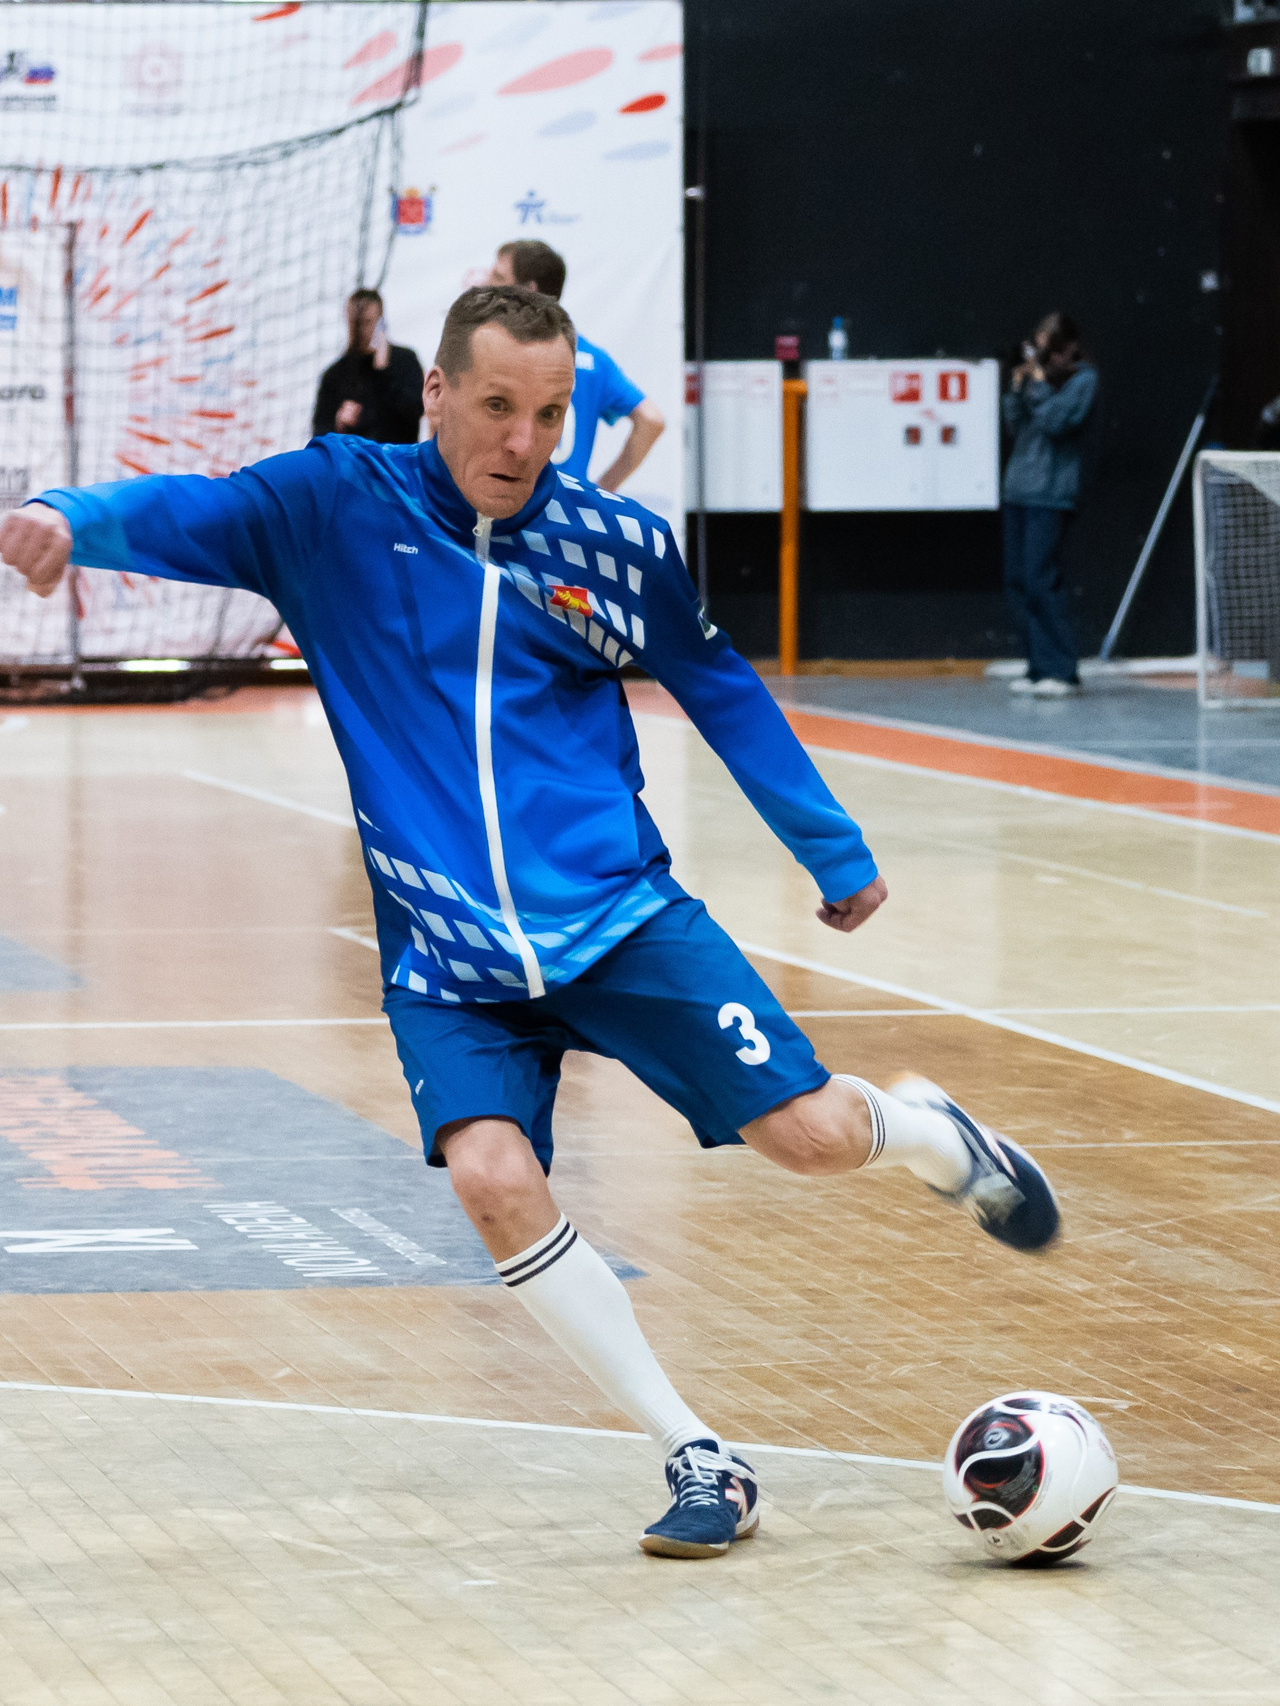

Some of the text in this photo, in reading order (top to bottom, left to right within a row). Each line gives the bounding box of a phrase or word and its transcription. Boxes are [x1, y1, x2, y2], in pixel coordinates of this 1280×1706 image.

[393, 542, 419, 554] Hitch
[718, 1002, 771, 1065] 3
[203, 1200, 388, 1277] NOVA ARENA
